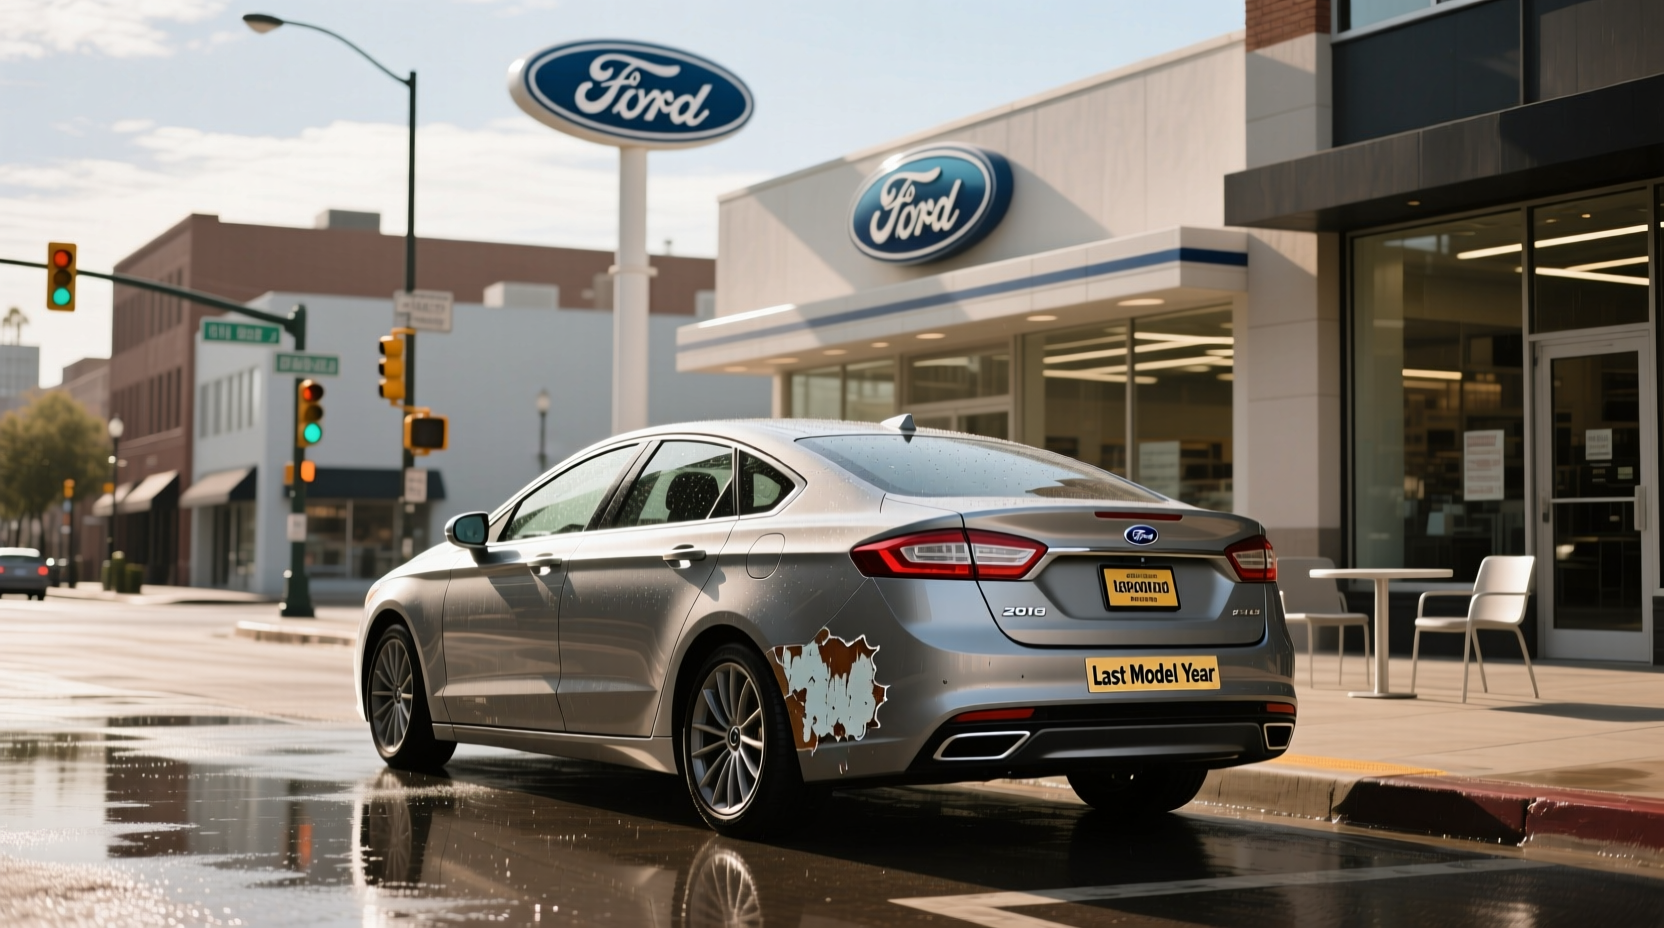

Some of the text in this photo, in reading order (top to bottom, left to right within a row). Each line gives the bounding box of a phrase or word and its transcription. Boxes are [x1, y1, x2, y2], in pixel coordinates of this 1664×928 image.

[574, 53, 713, 127] Ford
[869, 165, 962, 244] Ford
[1092, 662, 1215, 686] Last Model Year
